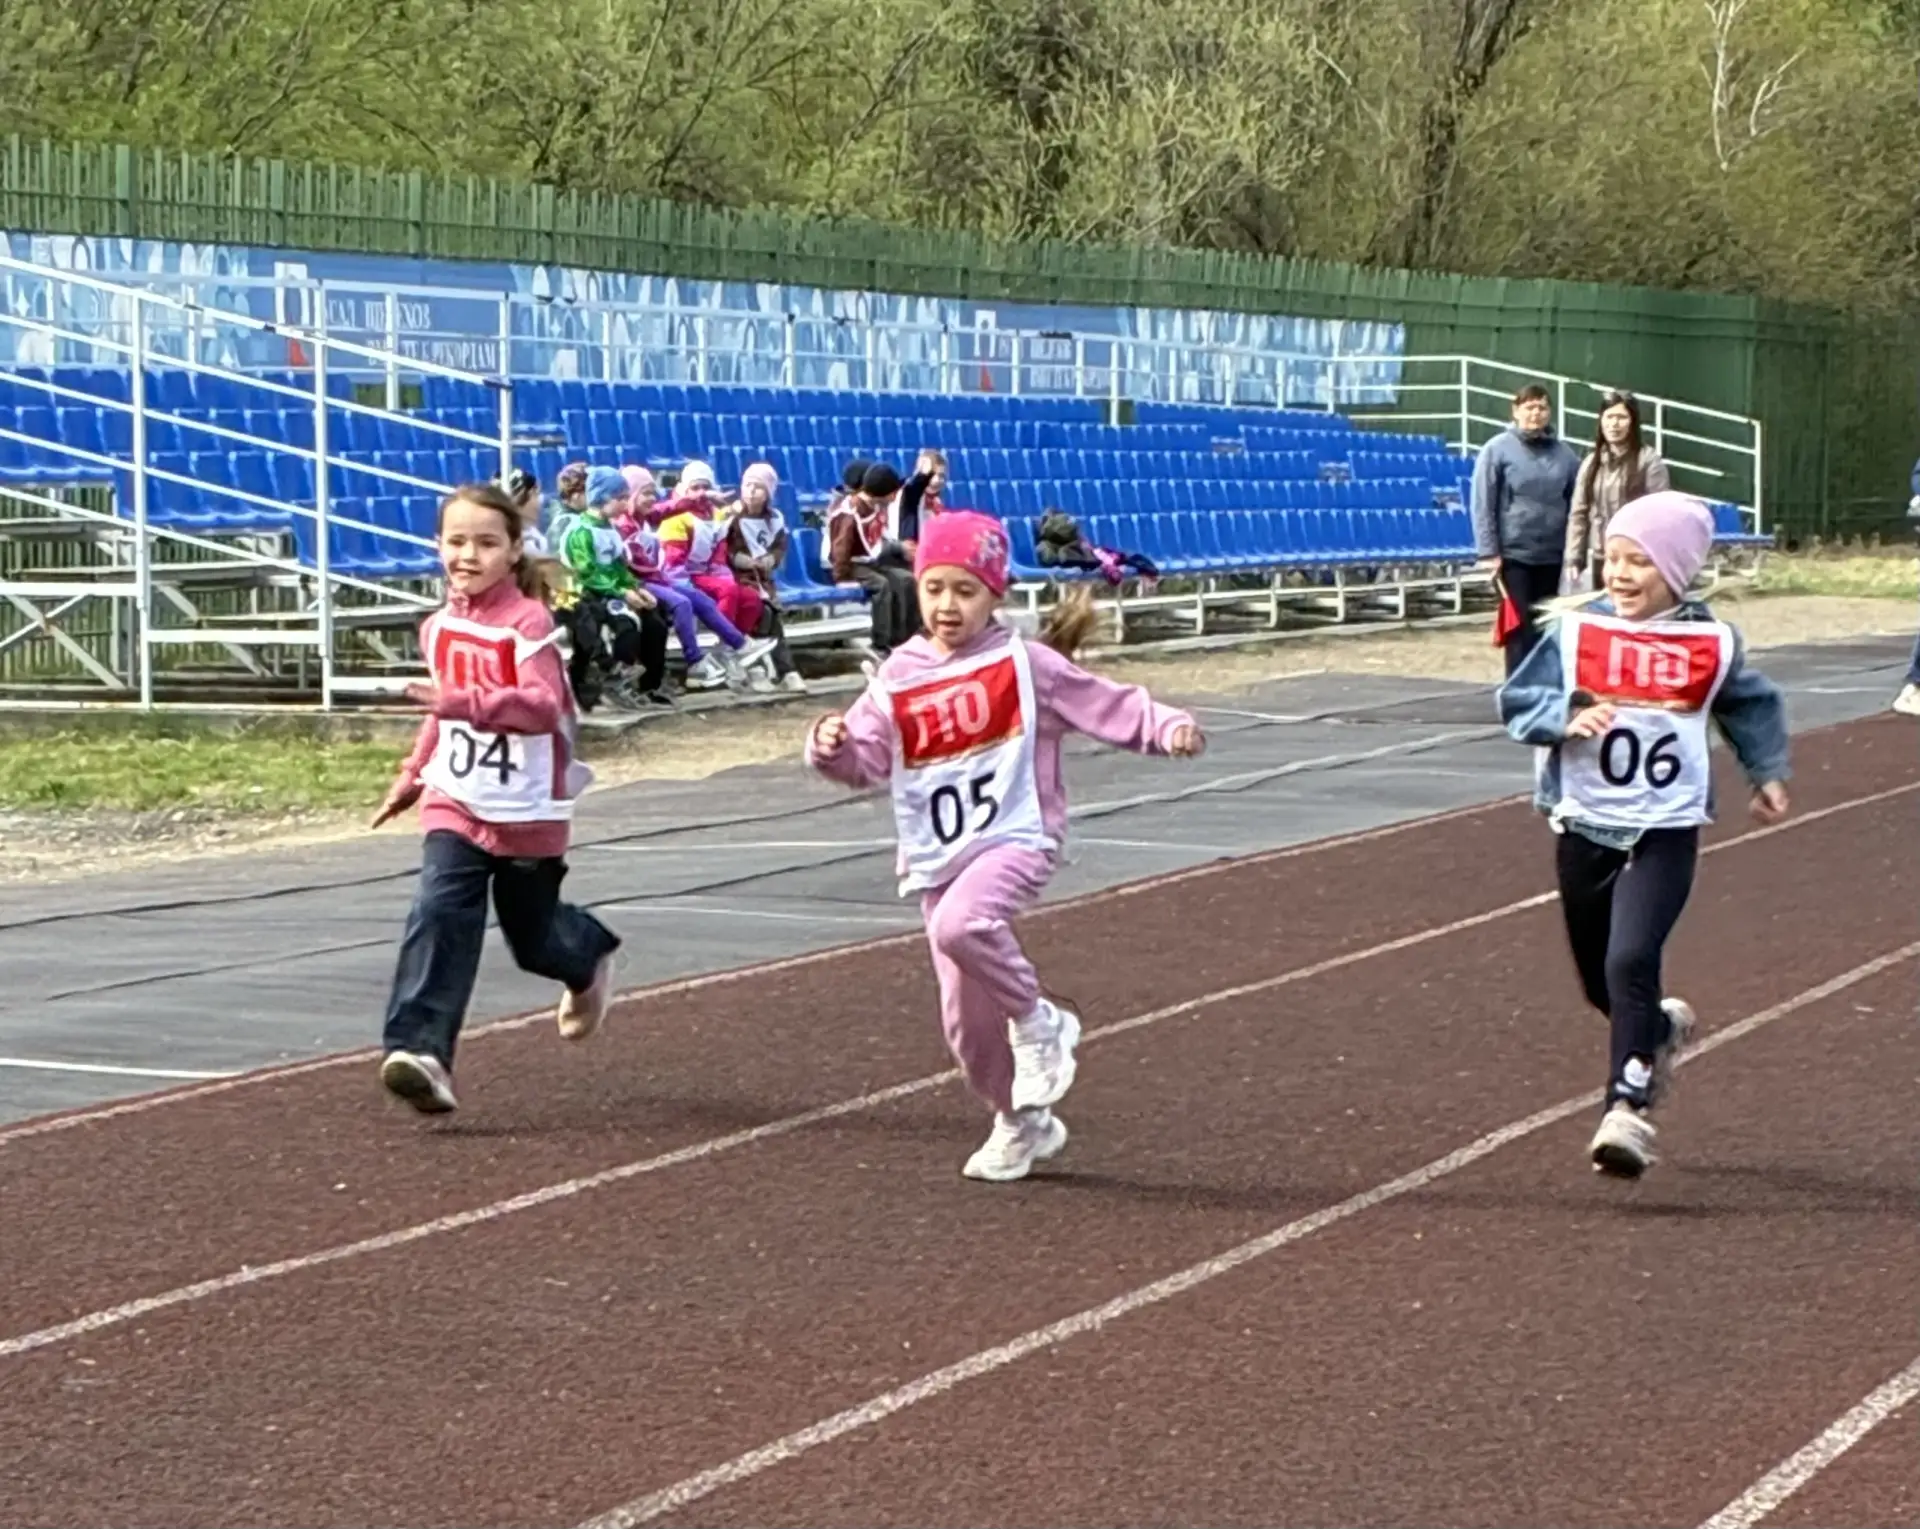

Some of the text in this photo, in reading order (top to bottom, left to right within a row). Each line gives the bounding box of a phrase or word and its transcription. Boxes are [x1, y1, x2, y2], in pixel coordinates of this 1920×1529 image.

[449, 727, 518, 785] 04
[1600, 727, 1681, 789] 06
[930, 772, 999, 845] 05
